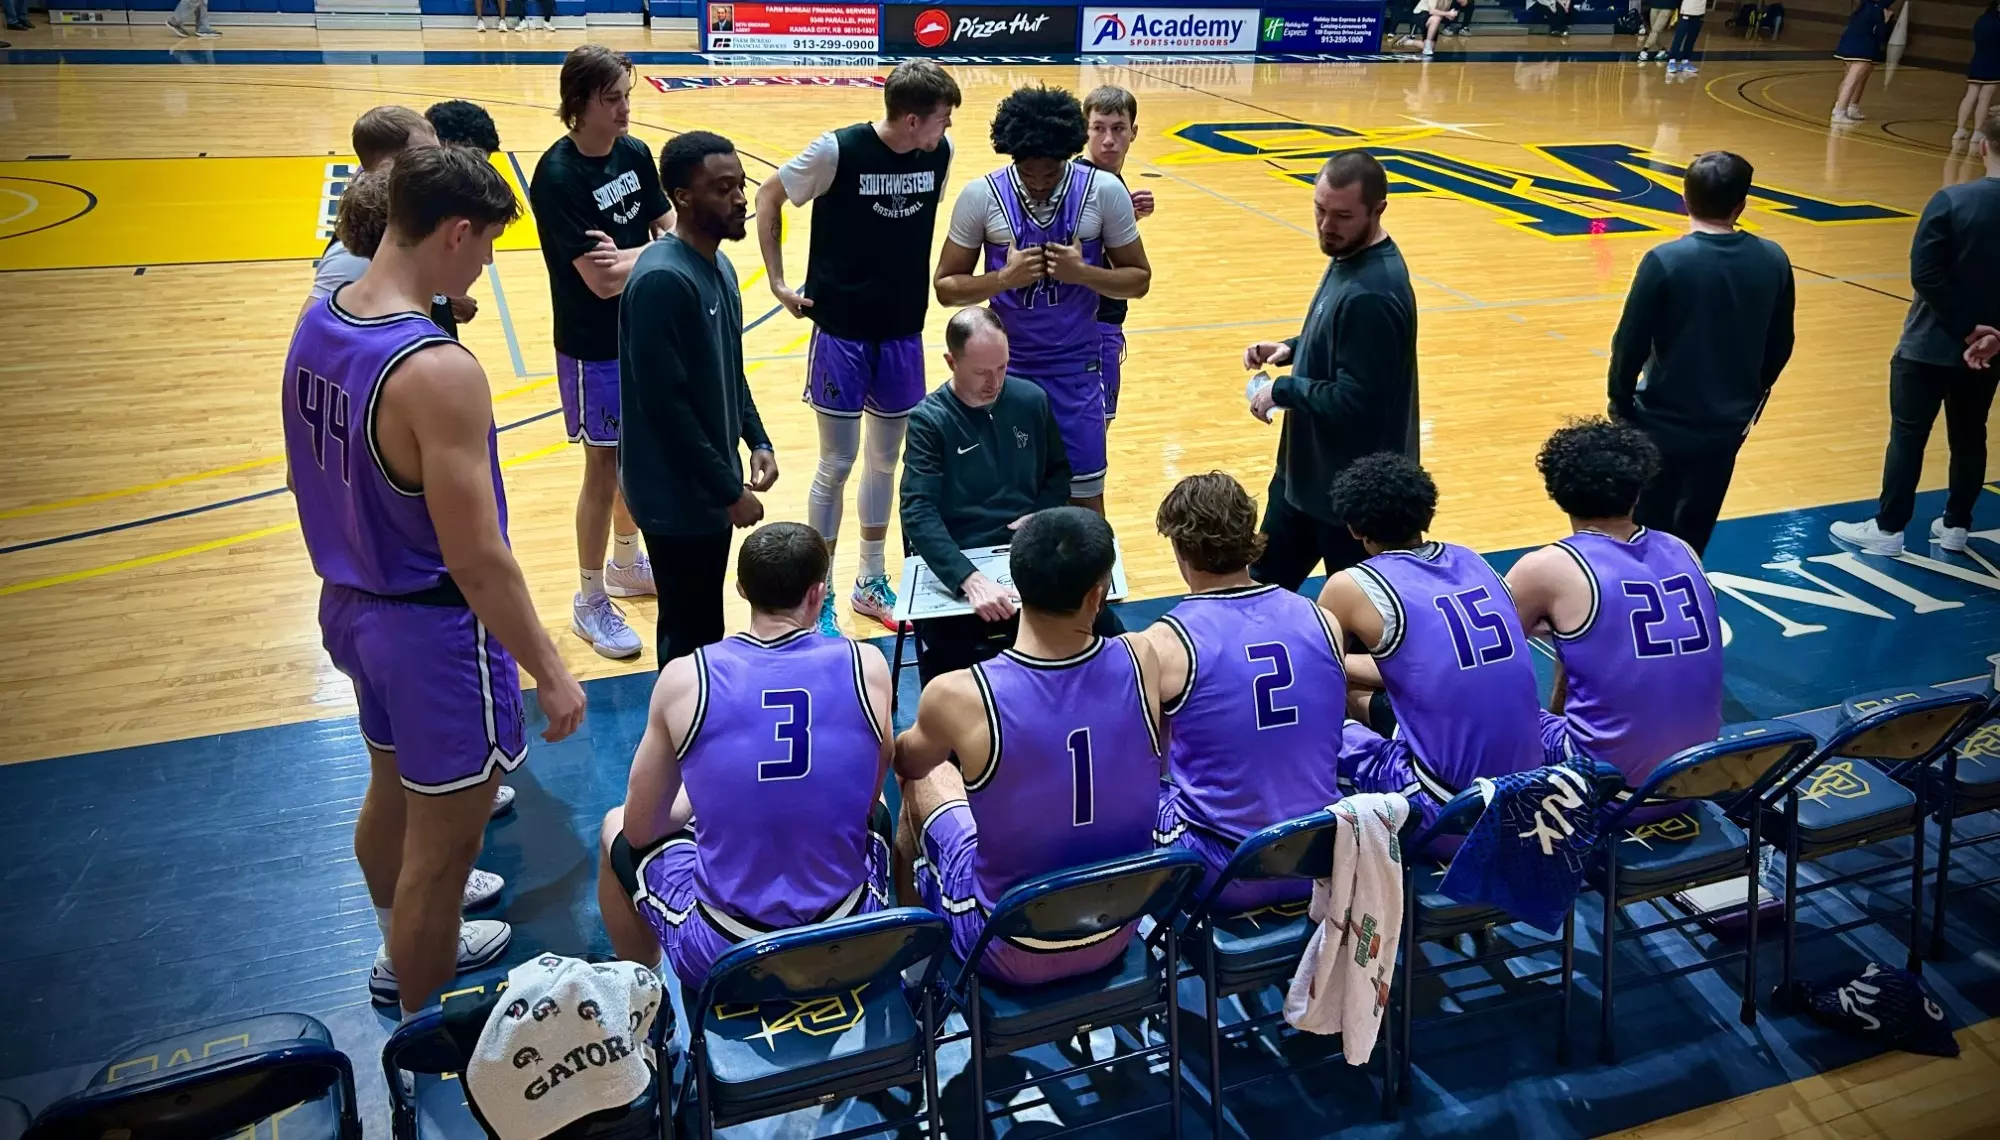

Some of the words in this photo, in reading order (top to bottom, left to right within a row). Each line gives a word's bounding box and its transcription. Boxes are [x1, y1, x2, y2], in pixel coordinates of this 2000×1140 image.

[793, 39, 875, 49] 913-299-0900
[953, 17, 1007, 41] Pizza
[1009, 13, 1050, 34] Hut
[1131, 13, 1244, 43] Academy
[1283, 29, 1308, 37] Express
[859, 171, 934, 195] SOUTHWESTERN
[872, 201, 924, 218] BASKETBALL
[296, 367, 351, 487] 44
[1433, 585, 1515, 670] 15
[1621, 573, 1711, 658] 23
[1244, 640, 1299, 731] 2
[757, 688, 812, 782] 3
[1067, 728, 1094, 827] 1
[524, 1035, 635, 1100] GATOR
